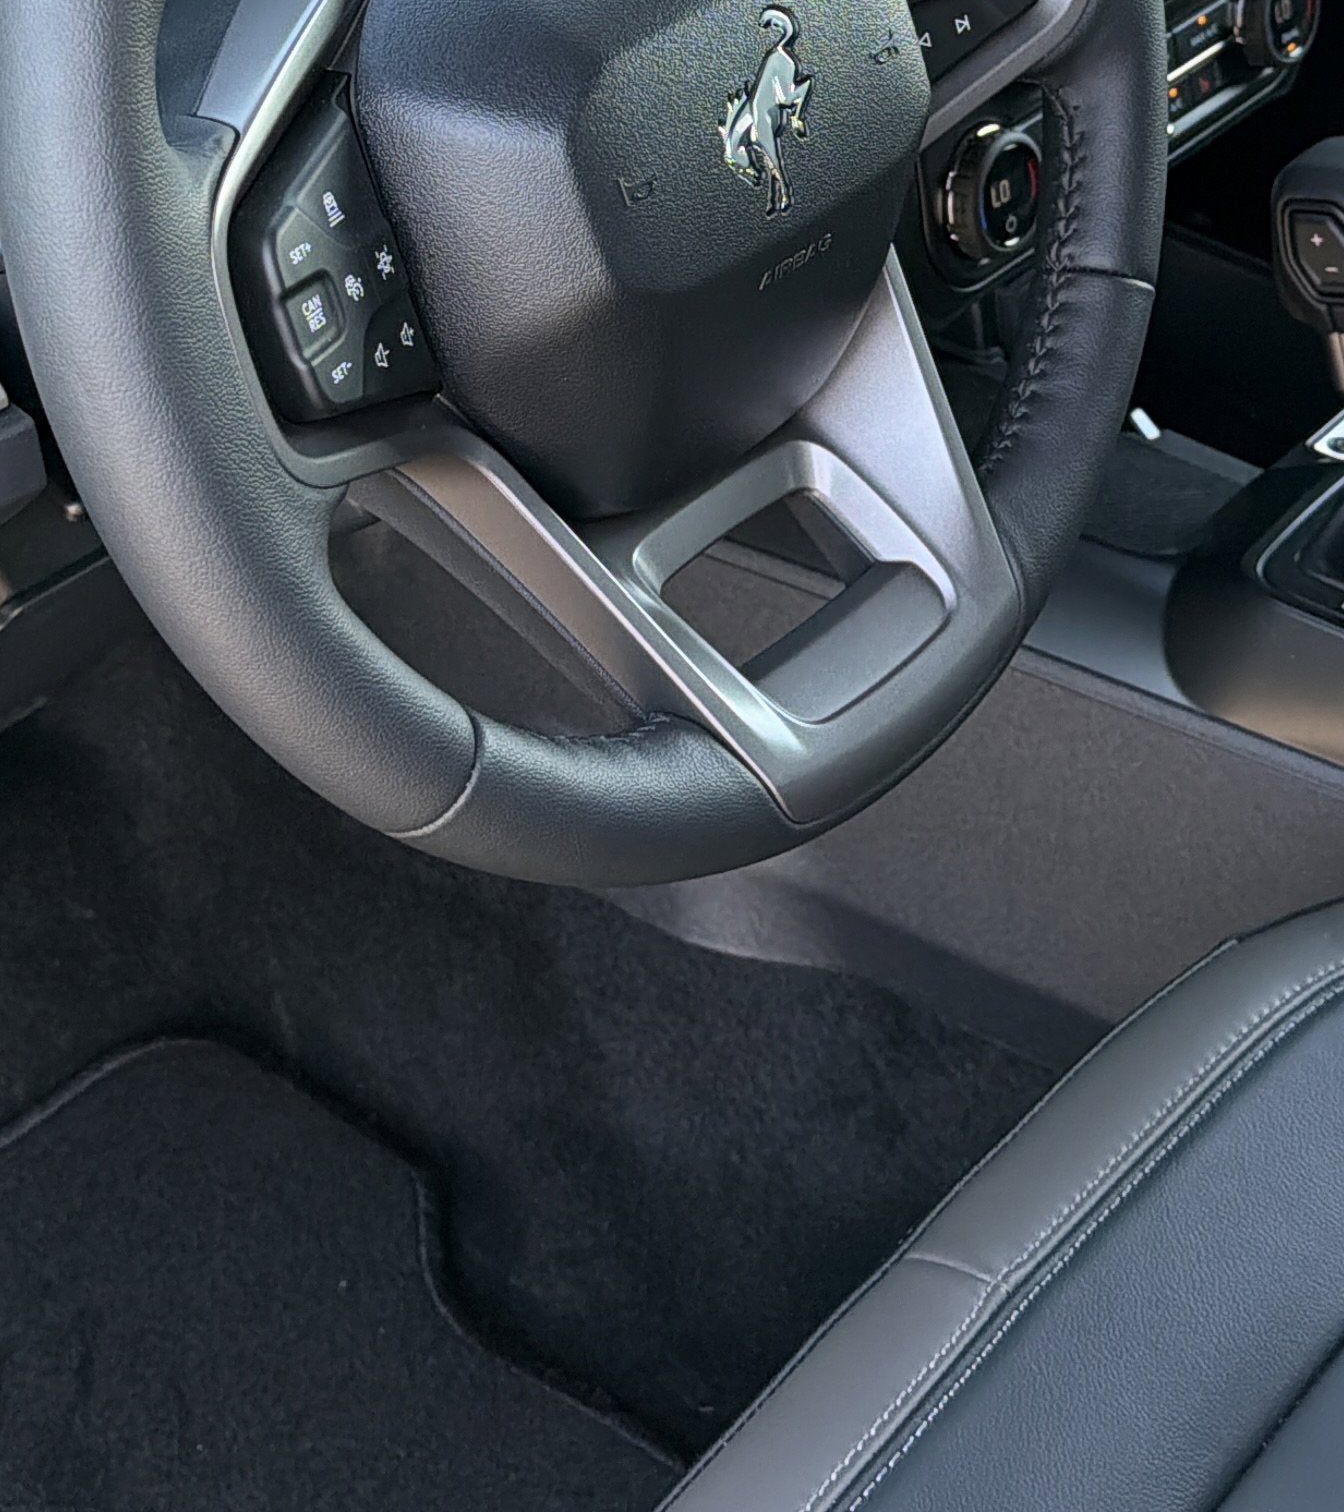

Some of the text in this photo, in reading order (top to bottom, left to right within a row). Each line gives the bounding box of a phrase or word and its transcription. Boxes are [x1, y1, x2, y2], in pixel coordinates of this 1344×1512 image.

[991, 179, 1011, 208] LO
[758, 233, 832, 291] AIRBAG
[302, 294, 322, 317] CAN
[308, 313, 327, 333] RES
